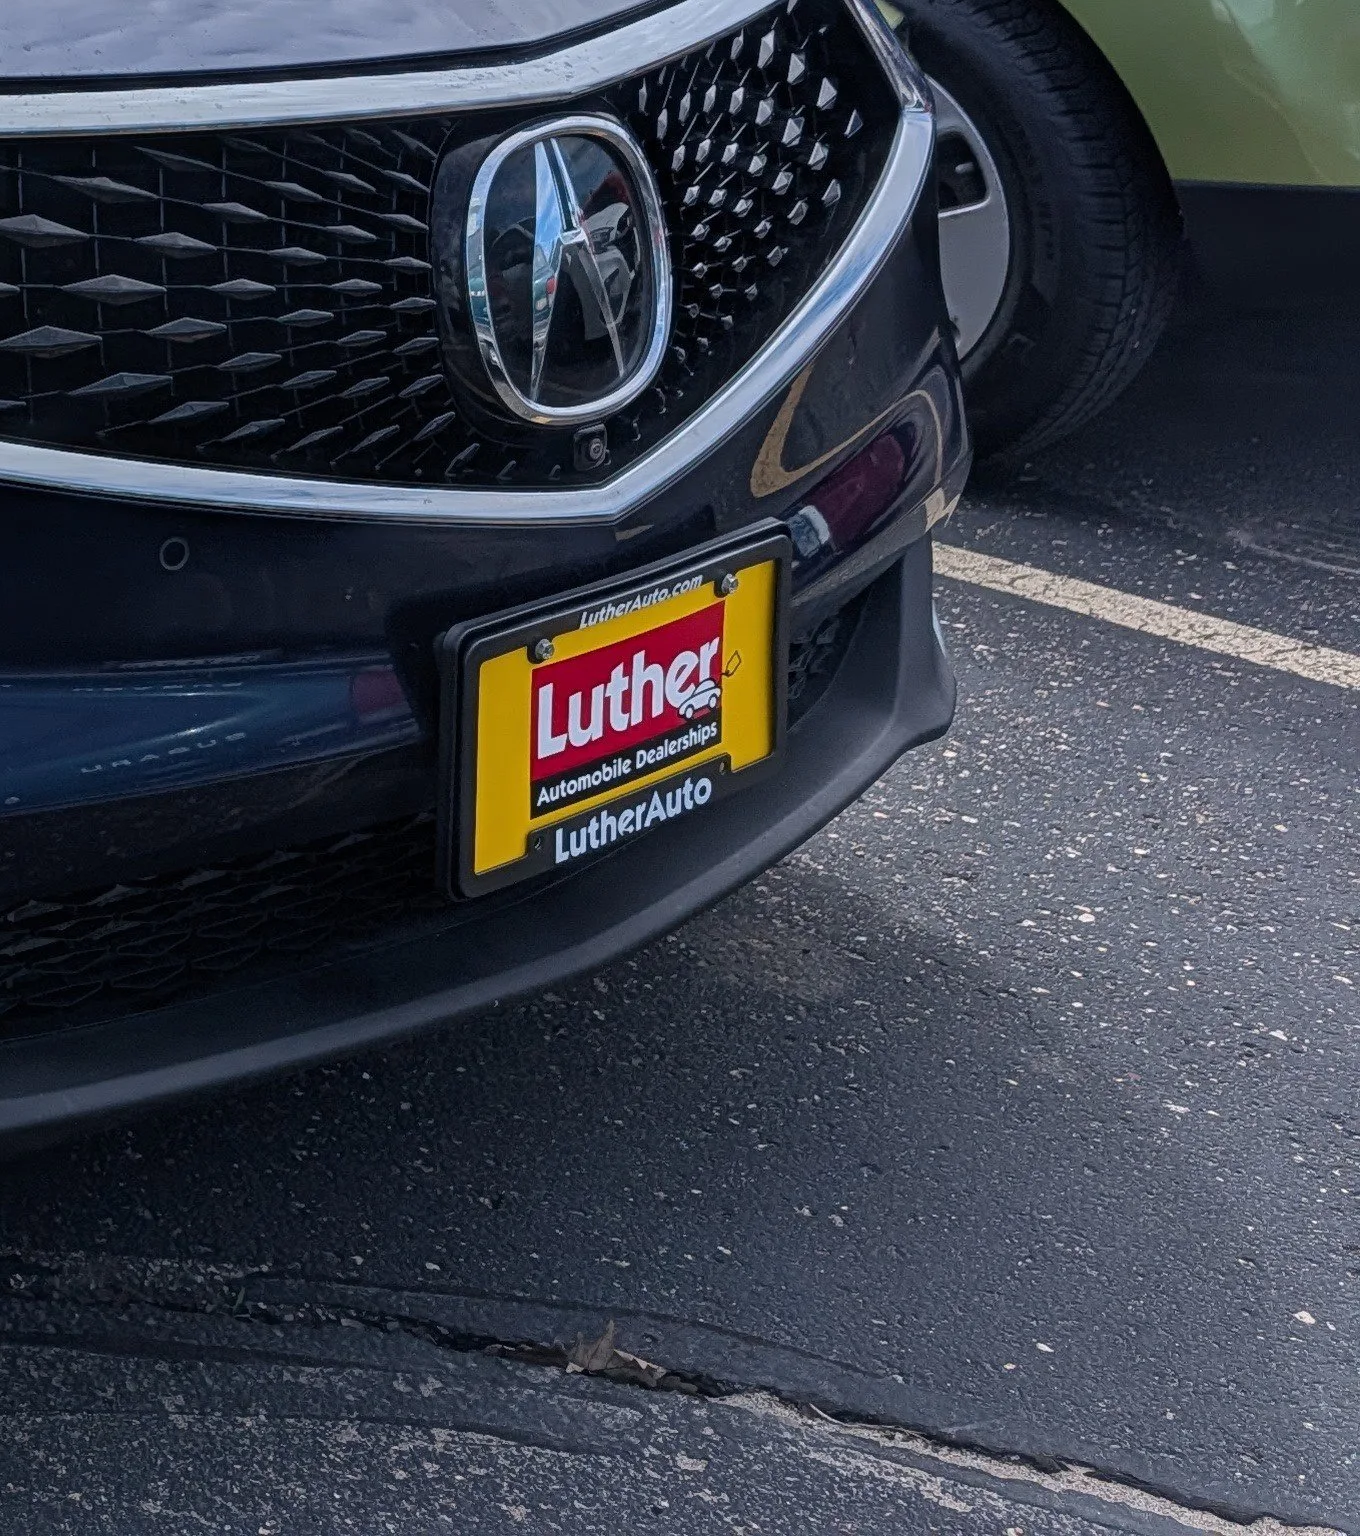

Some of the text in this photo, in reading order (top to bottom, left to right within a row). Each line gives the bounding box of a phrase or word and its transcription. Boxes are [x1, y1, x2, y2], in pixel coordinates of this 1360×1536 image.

[579, 574, 704, 630] LutherAuto.com
[537, 637, 721, 760] Luther
[536, 721, 718, 807] Automobile Dealerships
[555, 776, 713, 864] LutherAuto
